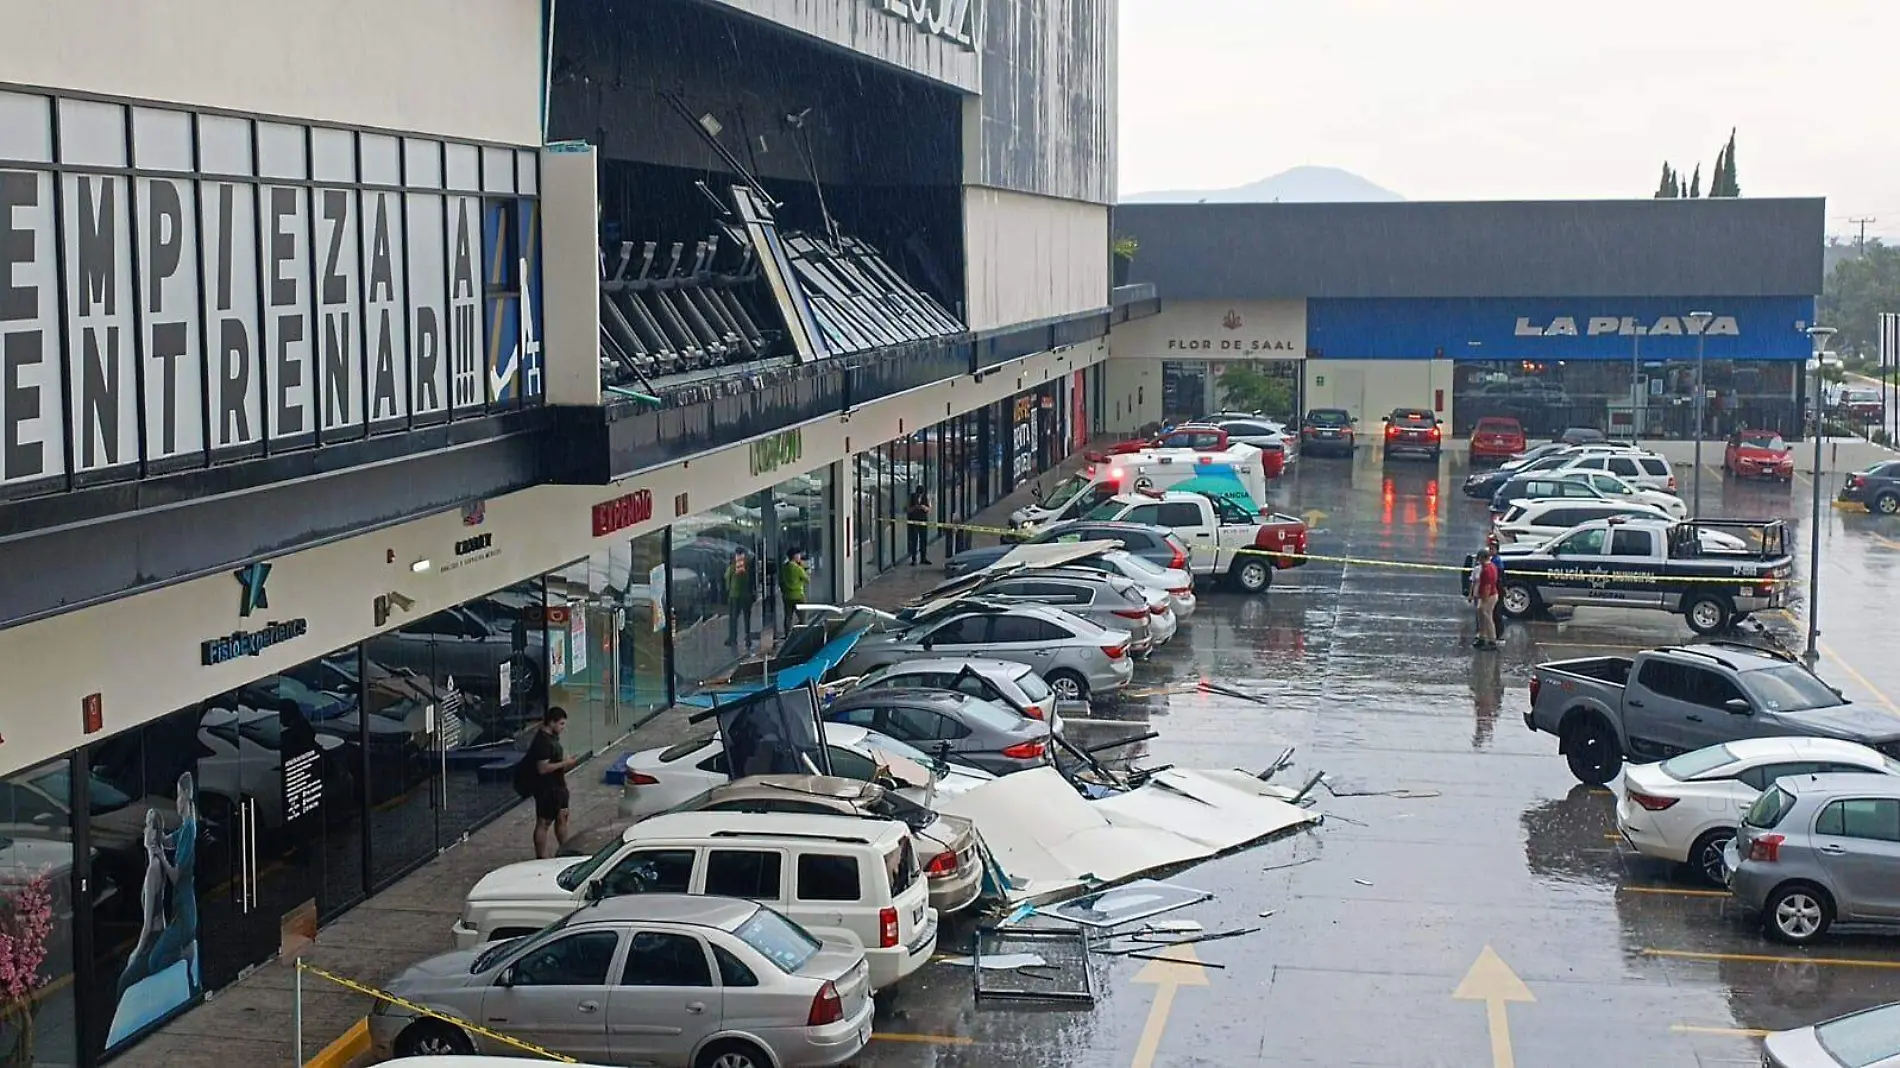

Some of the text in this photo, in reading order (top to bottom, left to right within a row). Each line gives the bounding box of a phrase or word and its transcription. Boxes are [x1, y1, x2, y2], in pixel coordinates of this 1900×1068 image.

[0, 171, 475, 321] EMPIEZA A
[1168, 339, 1295, 351] FLOR DE SAAL
[1515, 316, 1740, 336] LA PLAYA
[3, 303, 475, 480] ENTRENAR!!!
[592, 488, 652, 537] EXPENDIO
